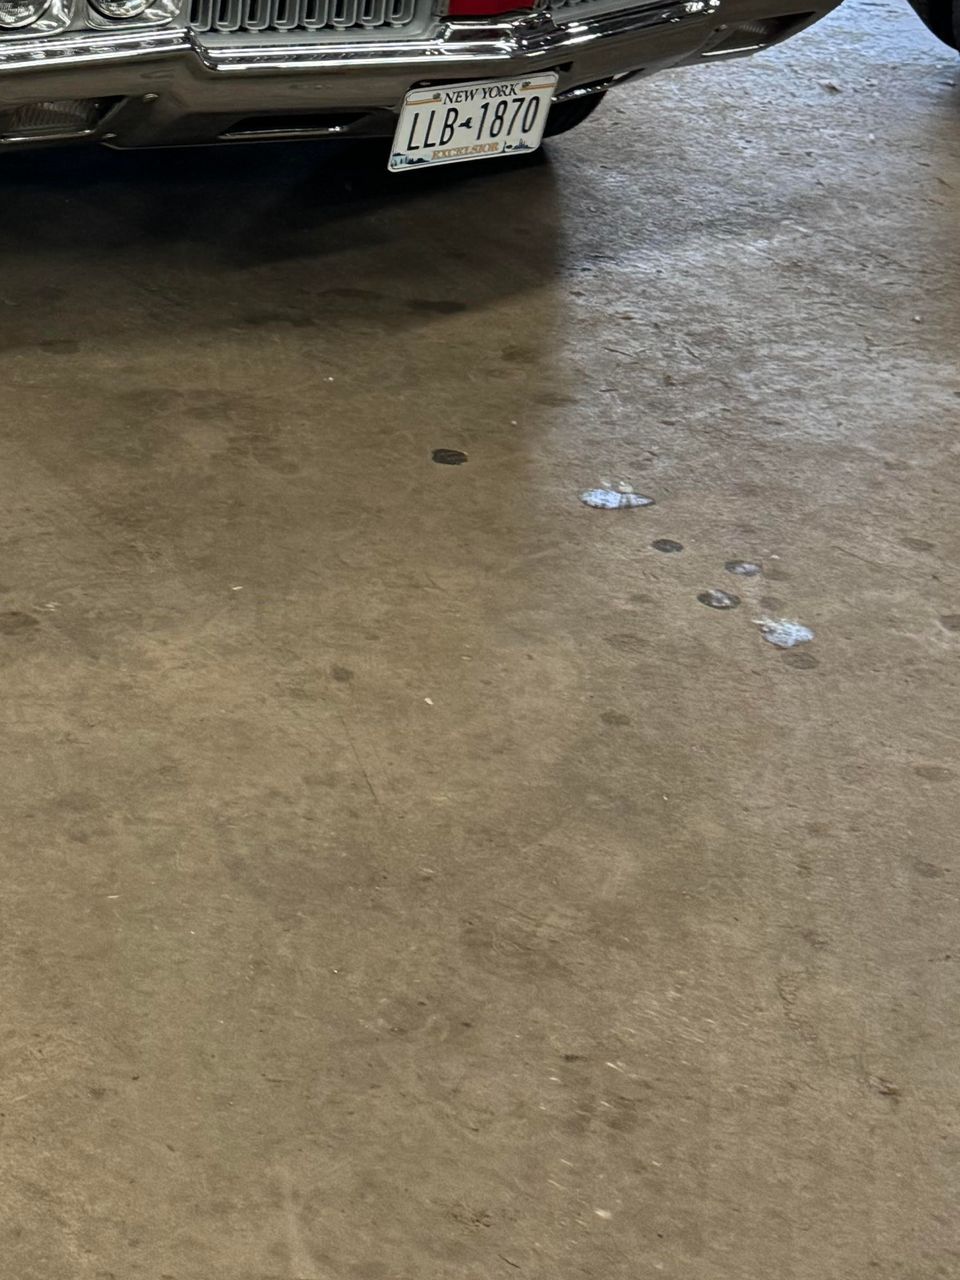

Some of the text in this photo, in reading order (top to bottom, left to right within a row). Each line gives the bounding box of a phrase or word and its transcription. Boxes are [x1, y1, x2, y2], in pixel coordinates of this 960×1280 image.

[442, 82, 521, 105] NEW YORK
[431, 142, 500, 160] EXCELSIOR
